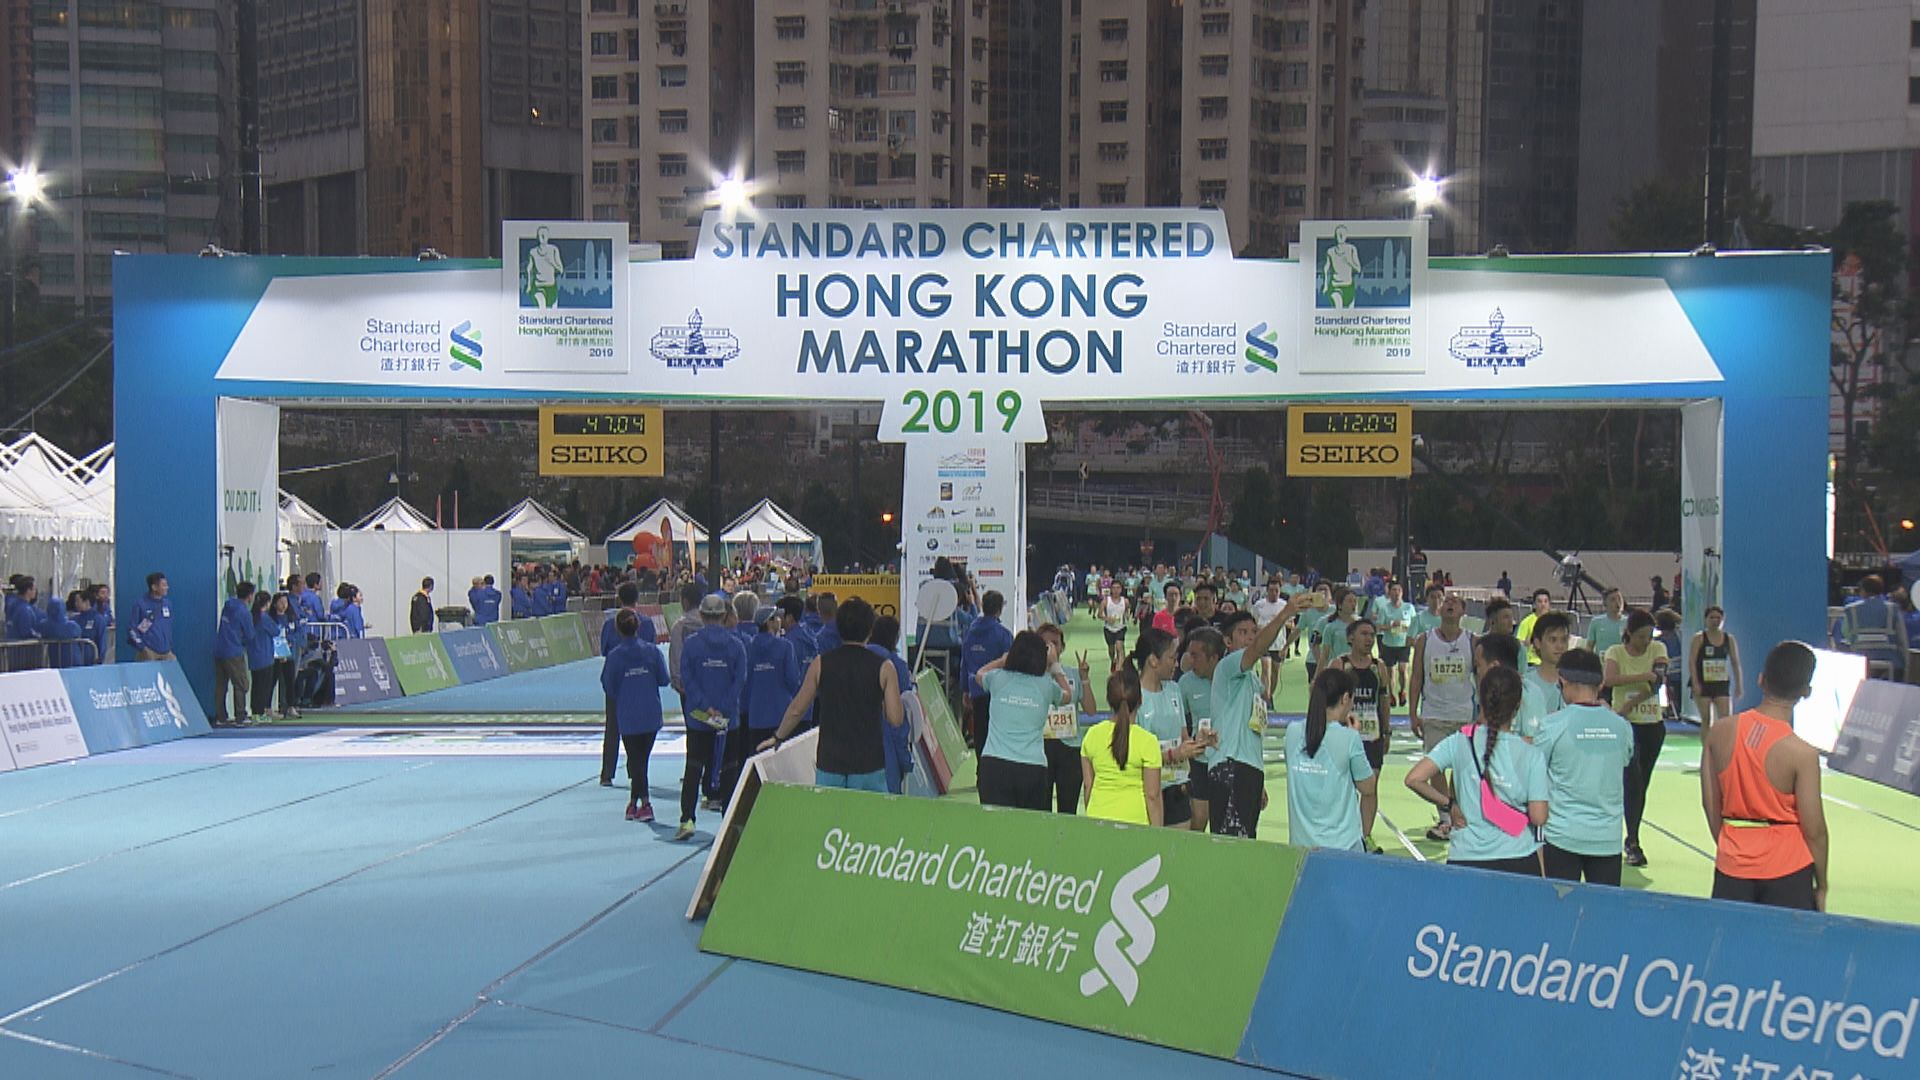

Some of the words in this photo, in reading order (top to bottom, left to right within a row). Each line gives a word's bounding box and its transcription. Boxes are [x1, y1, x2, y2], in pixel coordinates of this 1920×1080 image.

[713, 222, 946, 258] STANDARD
[962, 222, 1214, 258] CHARTERED
[776, 273, 952, 318] HONG
[975, 273, 1148, 318] KONG
[366, 318, 441, 335] Standard
[519, 316, 563, 325] Standard
[564, 316, 613, 325] Chartered
[1315, 316, 1360, 325] Standard
[1361, 316, 1411, 325] Chartered
[519, 326, 543, 336] Hong
[544, 326, 568, 336] Kong
[569, 326, 613, 336] Marathon
[1163, 322, 1236, 337] Standard
[1314, 327, 1340, 337] Hong
[1340, 326, 1365, 337] Kong
[1366, 327, 1411, 336] Marathon
[360, 336, 441, 353] Chartered
[589, 348, 614, 357] 2019
[796, 329, 1123, 374] MARATHON
[1156, 340, 1236, 355] Chartered
[1386, 348, 1411, 357] 2019
[1176, 359, 1236, 374] 渣打銀行
[901, 390, 1022, 434] 2019
[551, 445, 648, 465] SEIKO
[1300, 445, 1399, 464] SEIKO
[813, 576, 831, 585] Half
[833, 576, 878, 585] Marathon
[880, 576, 901, 585] Fini
[1047, 714, 1073, 727] 1281
[816, 827, 949, 887] Standard
[947, 845, 1103, 916] Chartered
[959, 911, 1079, 974] 渣打銀行
[1407, 924, 1629, 1010] Standard
[1634, 958, 1918, 1059] Chartered
